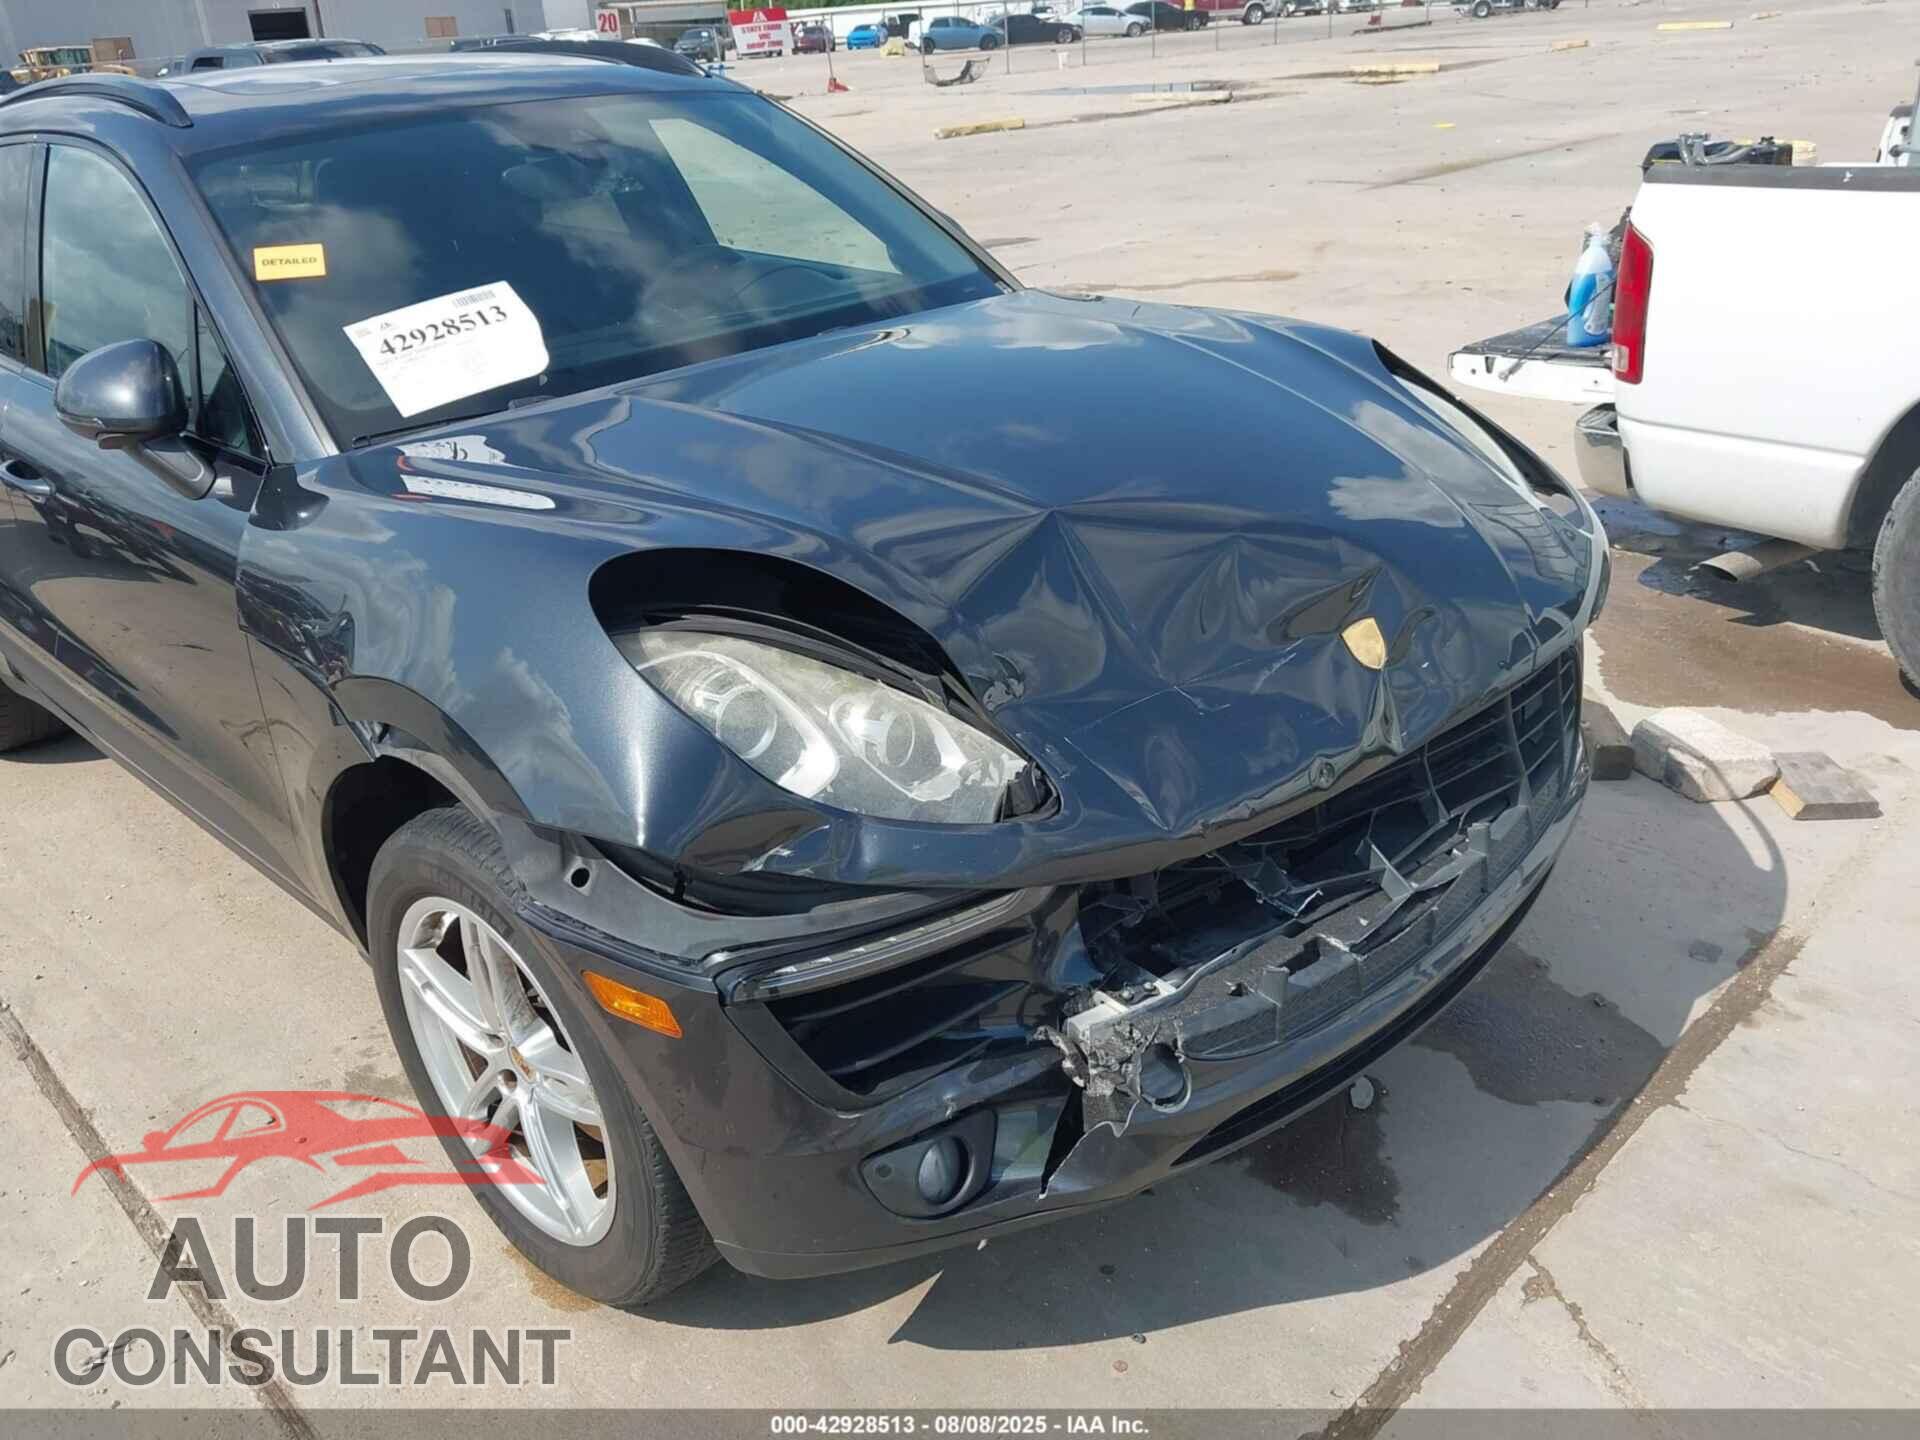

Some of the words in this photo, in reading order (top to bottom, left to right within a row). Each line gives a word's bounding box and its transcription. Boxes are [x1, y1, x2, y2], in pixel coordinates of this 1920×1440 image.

[598, 12, 617, 32] 20
[262, 256, 317, 266] DETAILED
[379, 305, 508, 356] 42928513
